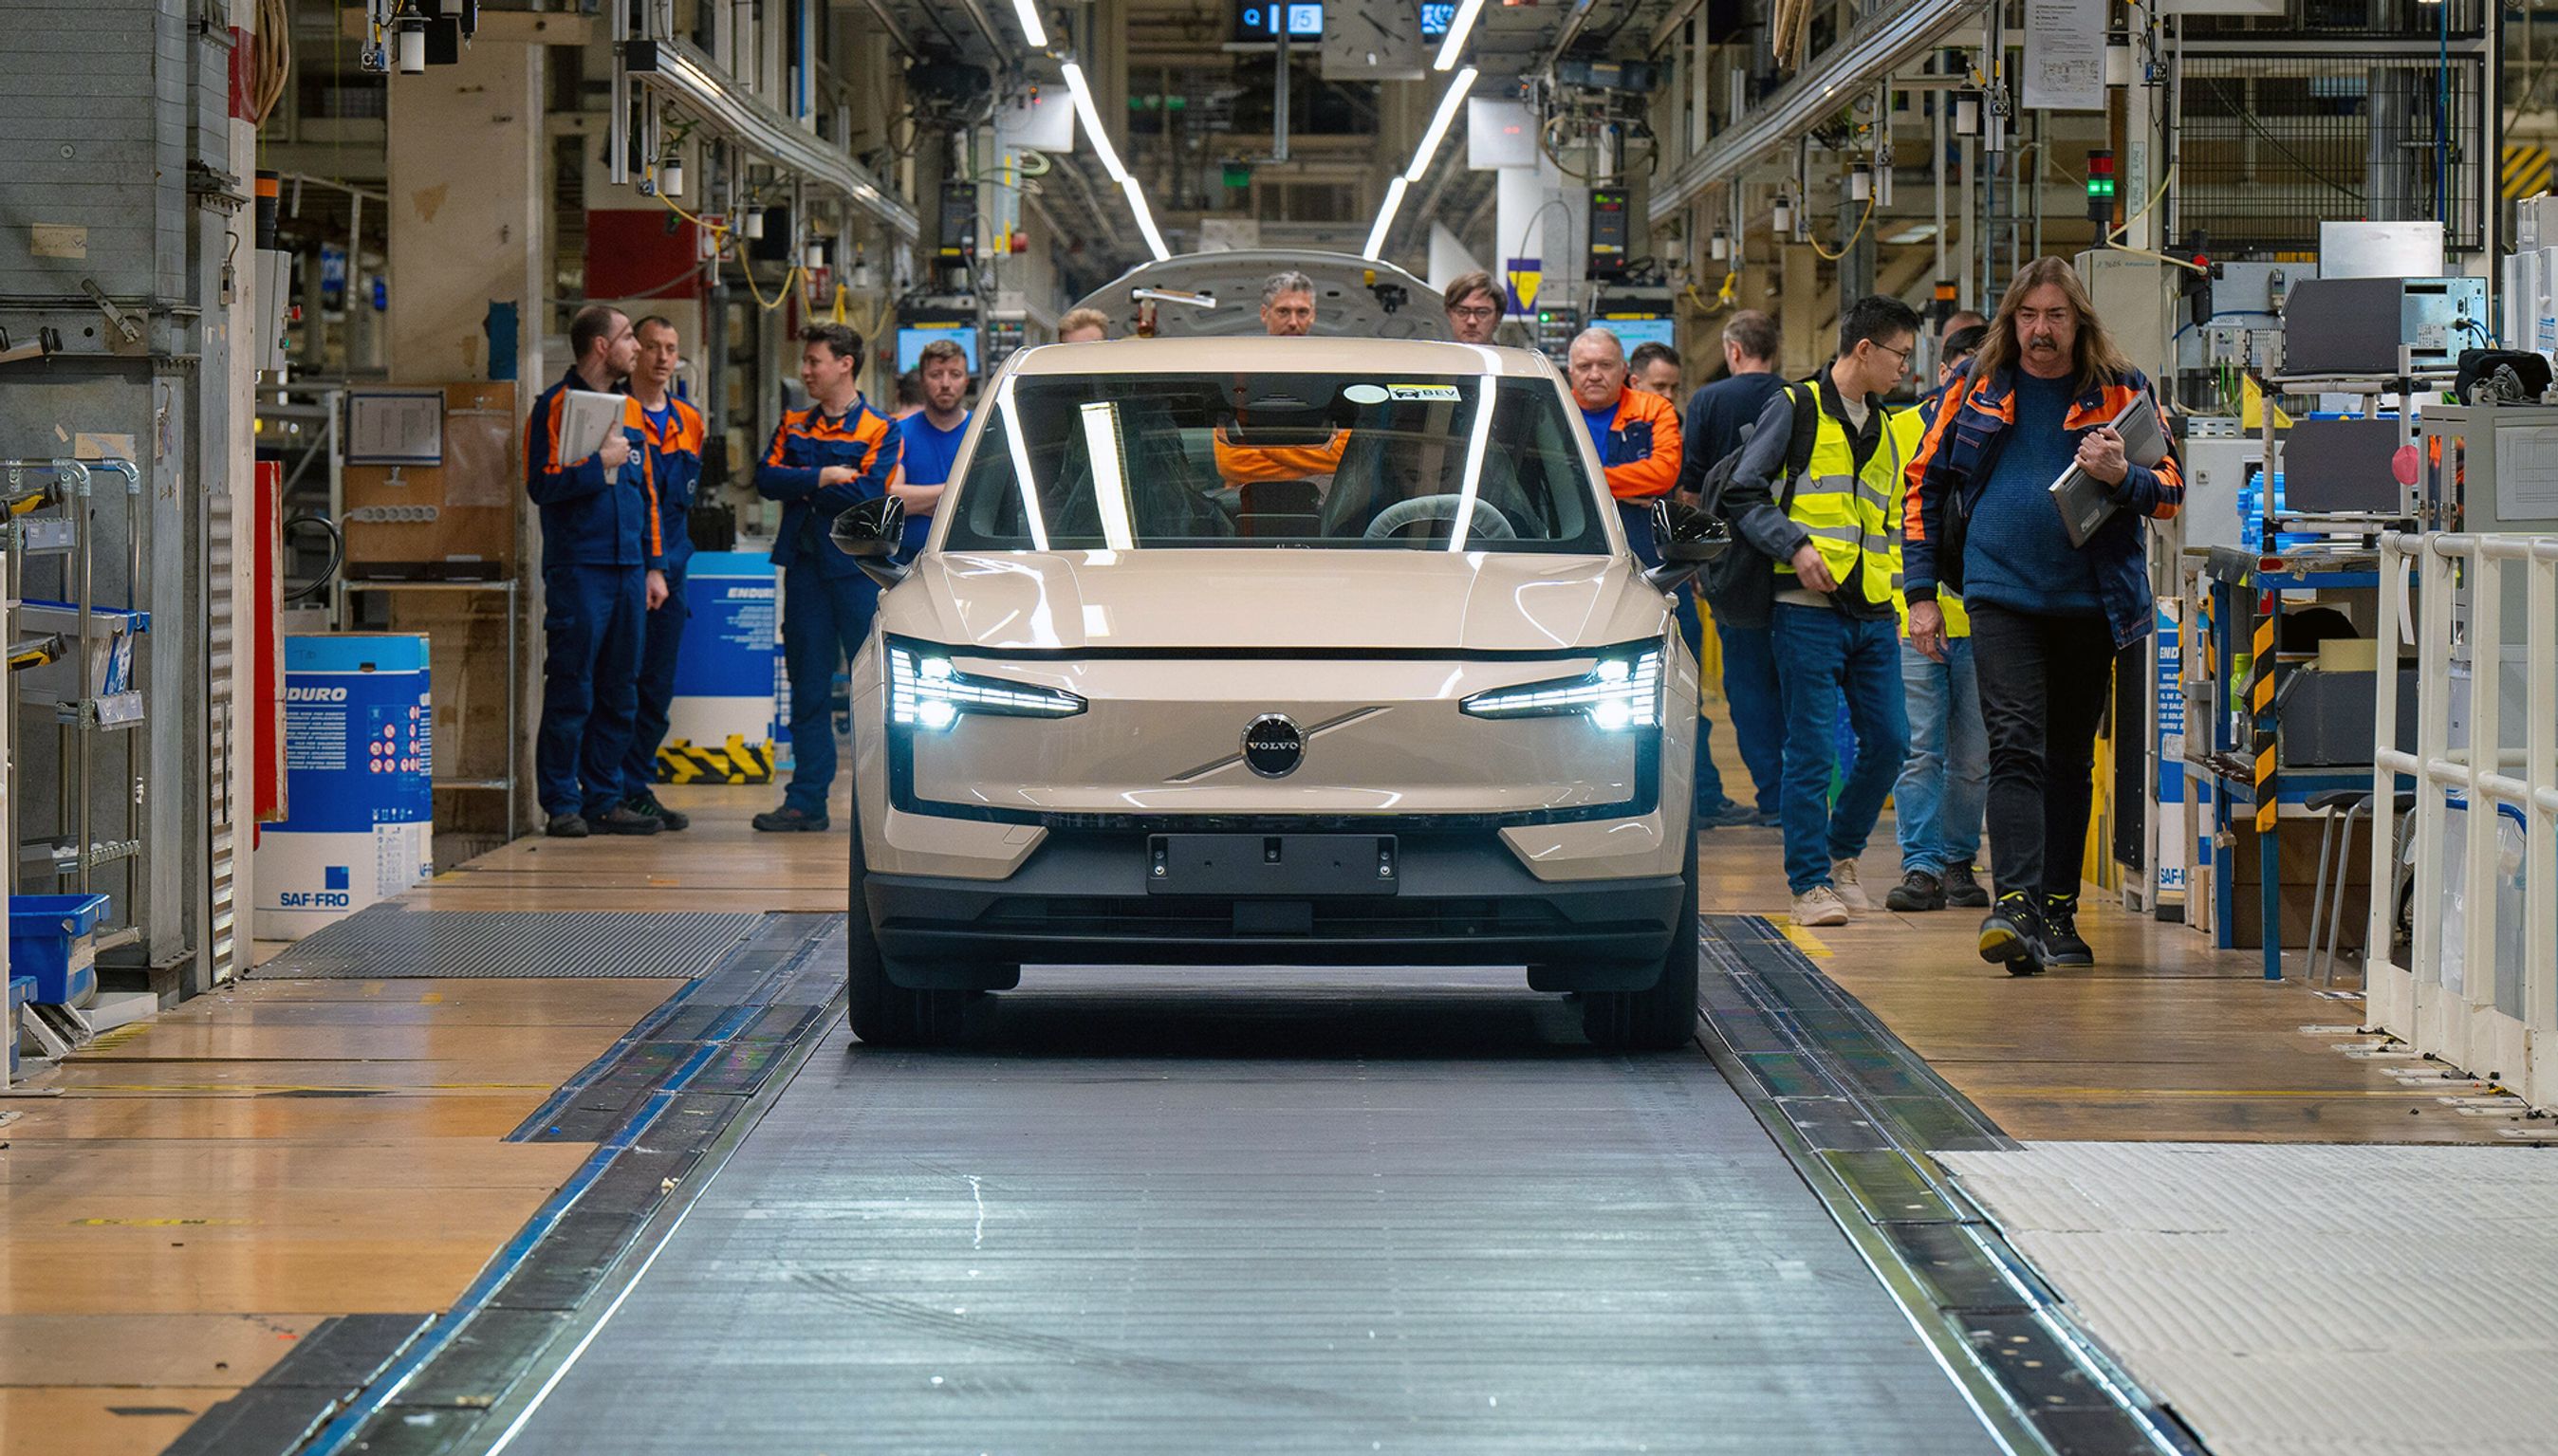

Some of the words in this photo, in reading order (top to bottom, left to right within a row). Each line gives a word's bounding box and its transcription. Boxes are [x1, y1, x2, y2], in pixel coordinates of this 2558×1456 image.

[286, 687, 348, 701] DURO
[1248, 742, 1299, 750] VOLVO
[280, 892, 350, 907] SAF-FRO
